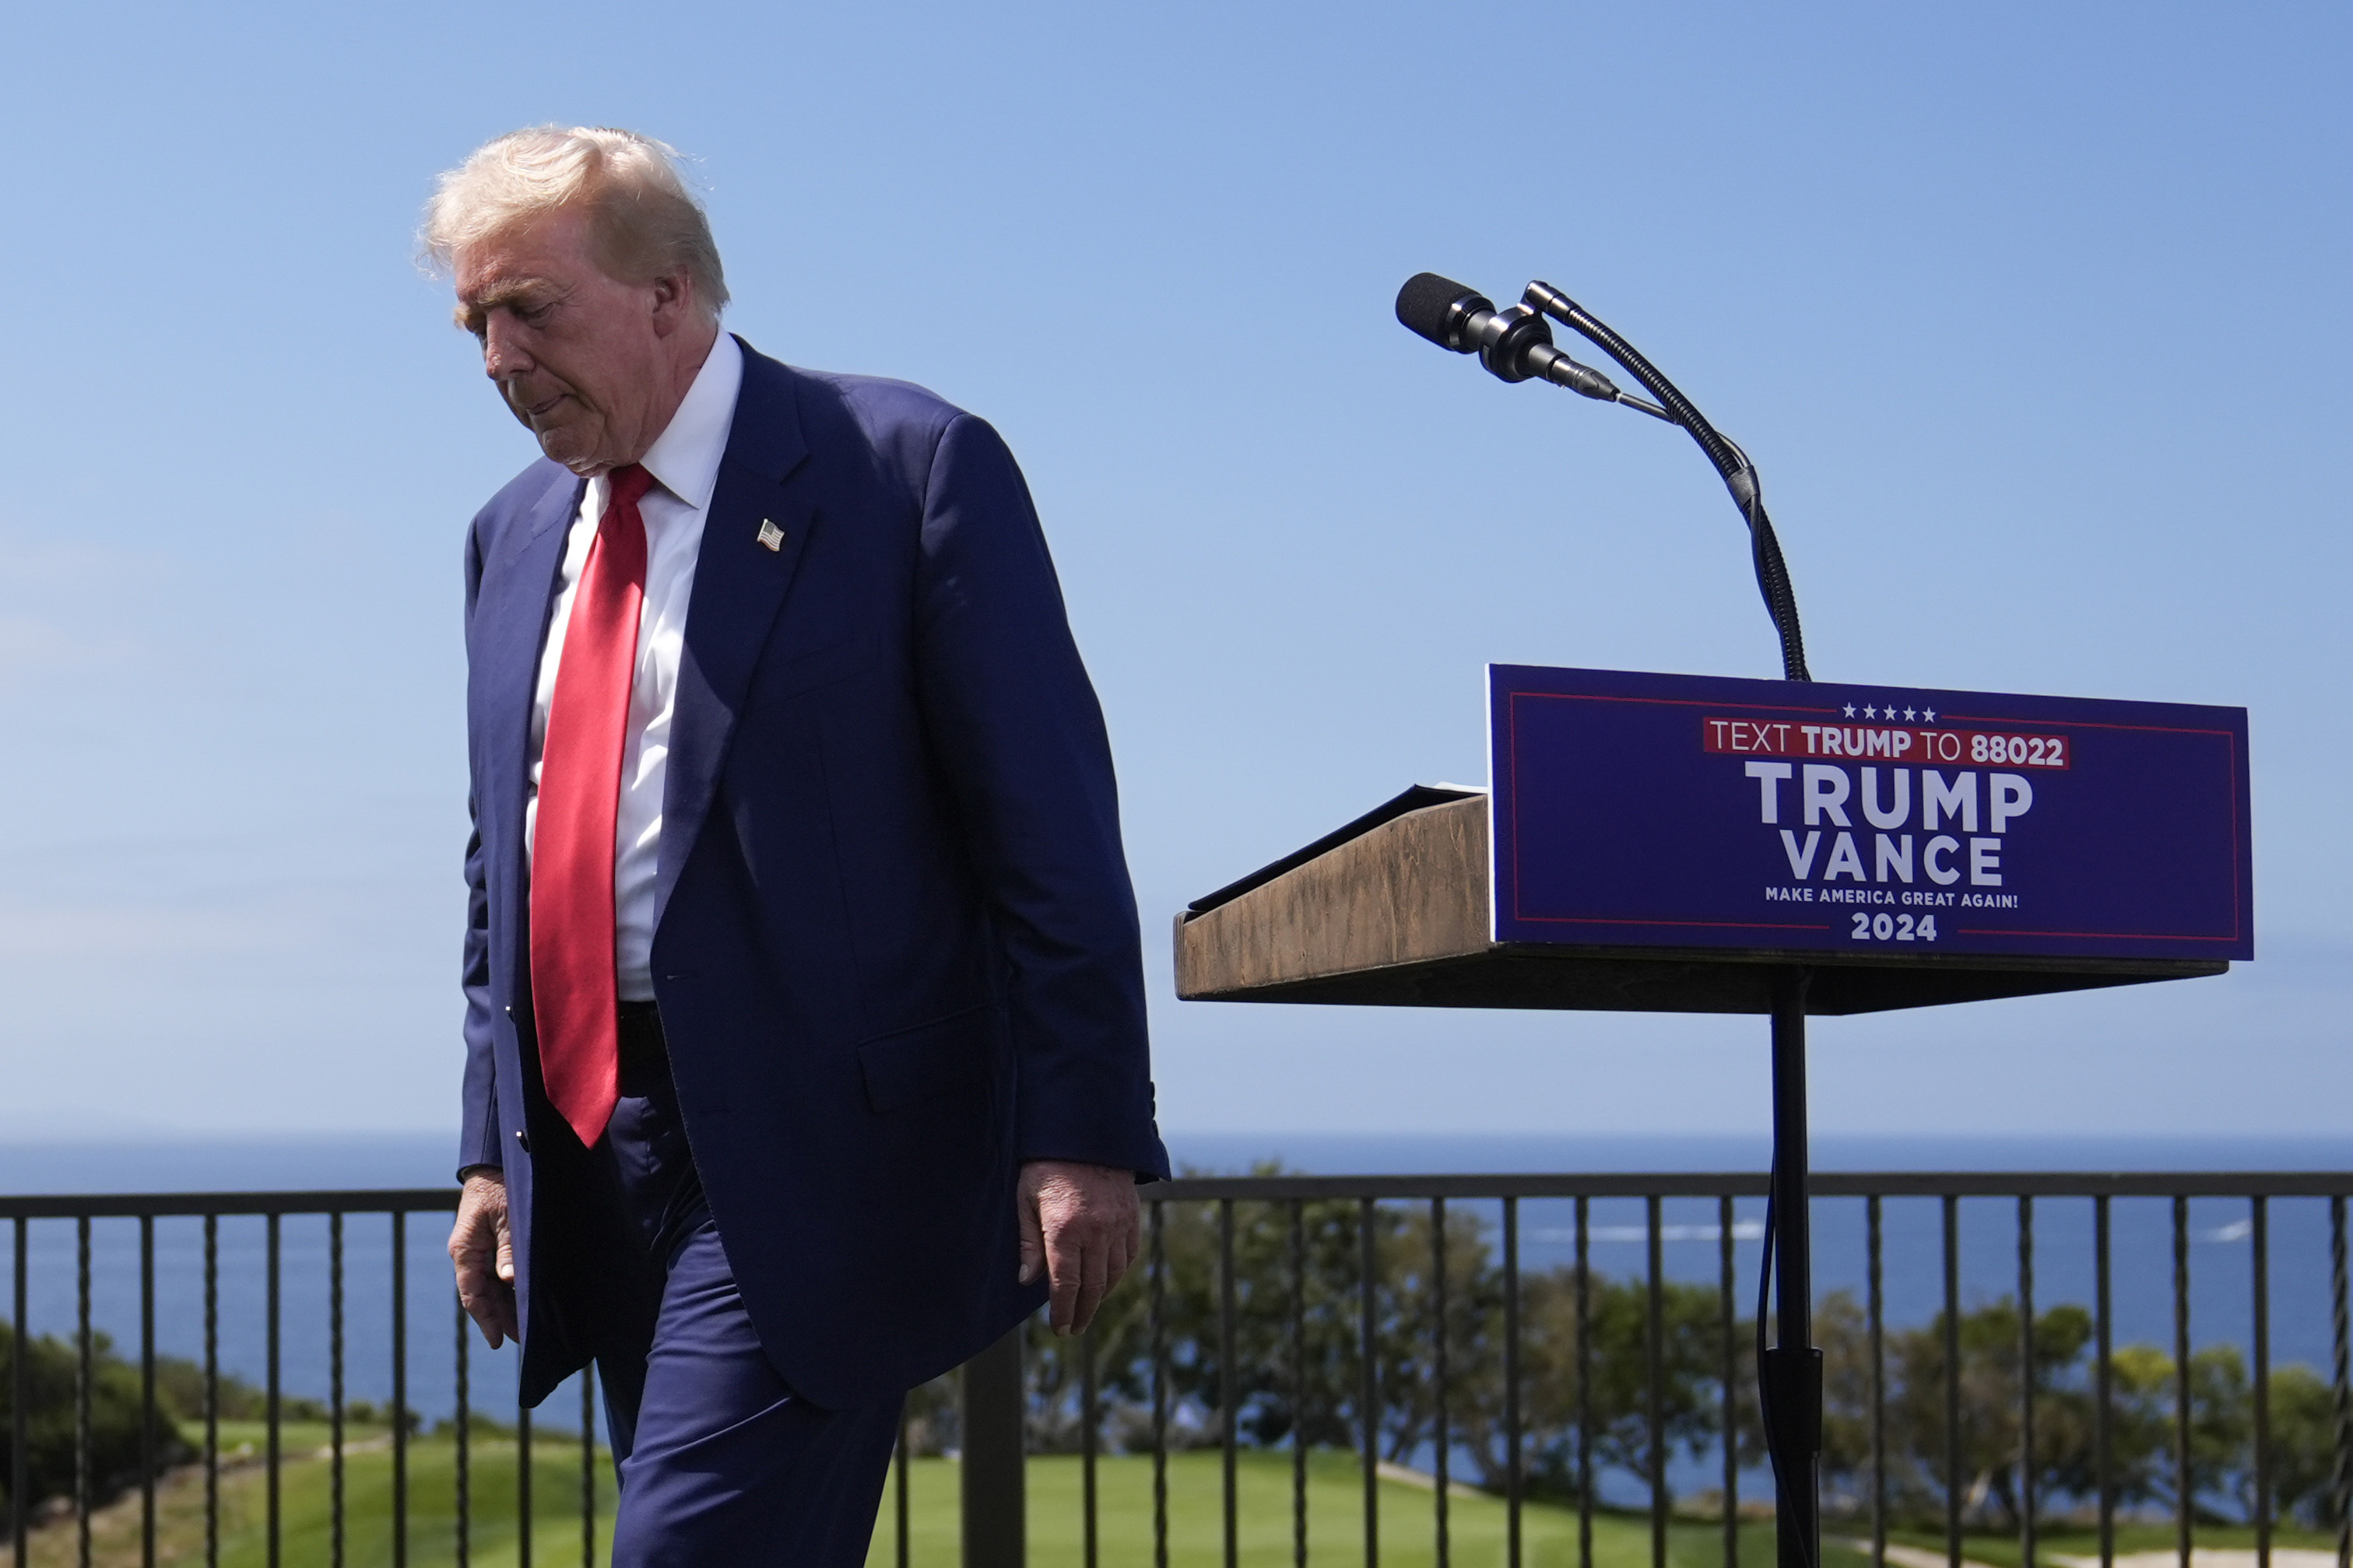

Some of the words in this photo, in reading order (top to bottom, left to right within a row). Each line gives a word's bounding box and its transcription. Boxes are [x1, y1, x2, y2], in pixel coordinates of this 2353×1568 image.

[1709, 721, 1791, 752] TEXT
[1800, 725, 1912, 758] TRUMP
[1919, 731, 1961, 761] TO
[1971, 734, 2063, 766] 88022
[1744, 760, 2033, 833] TRUMP
[1779, 829, 2002, 886] VANCE
[1765, 886, 1813, 902] MAKE
[1819, 889, 1895, 904] AMERICA
[1901, 891, 1955, 907] GREAT
[1961, 893, 2018, 908] AGAIN!
[1851, 912, 1937, 942] 2024
